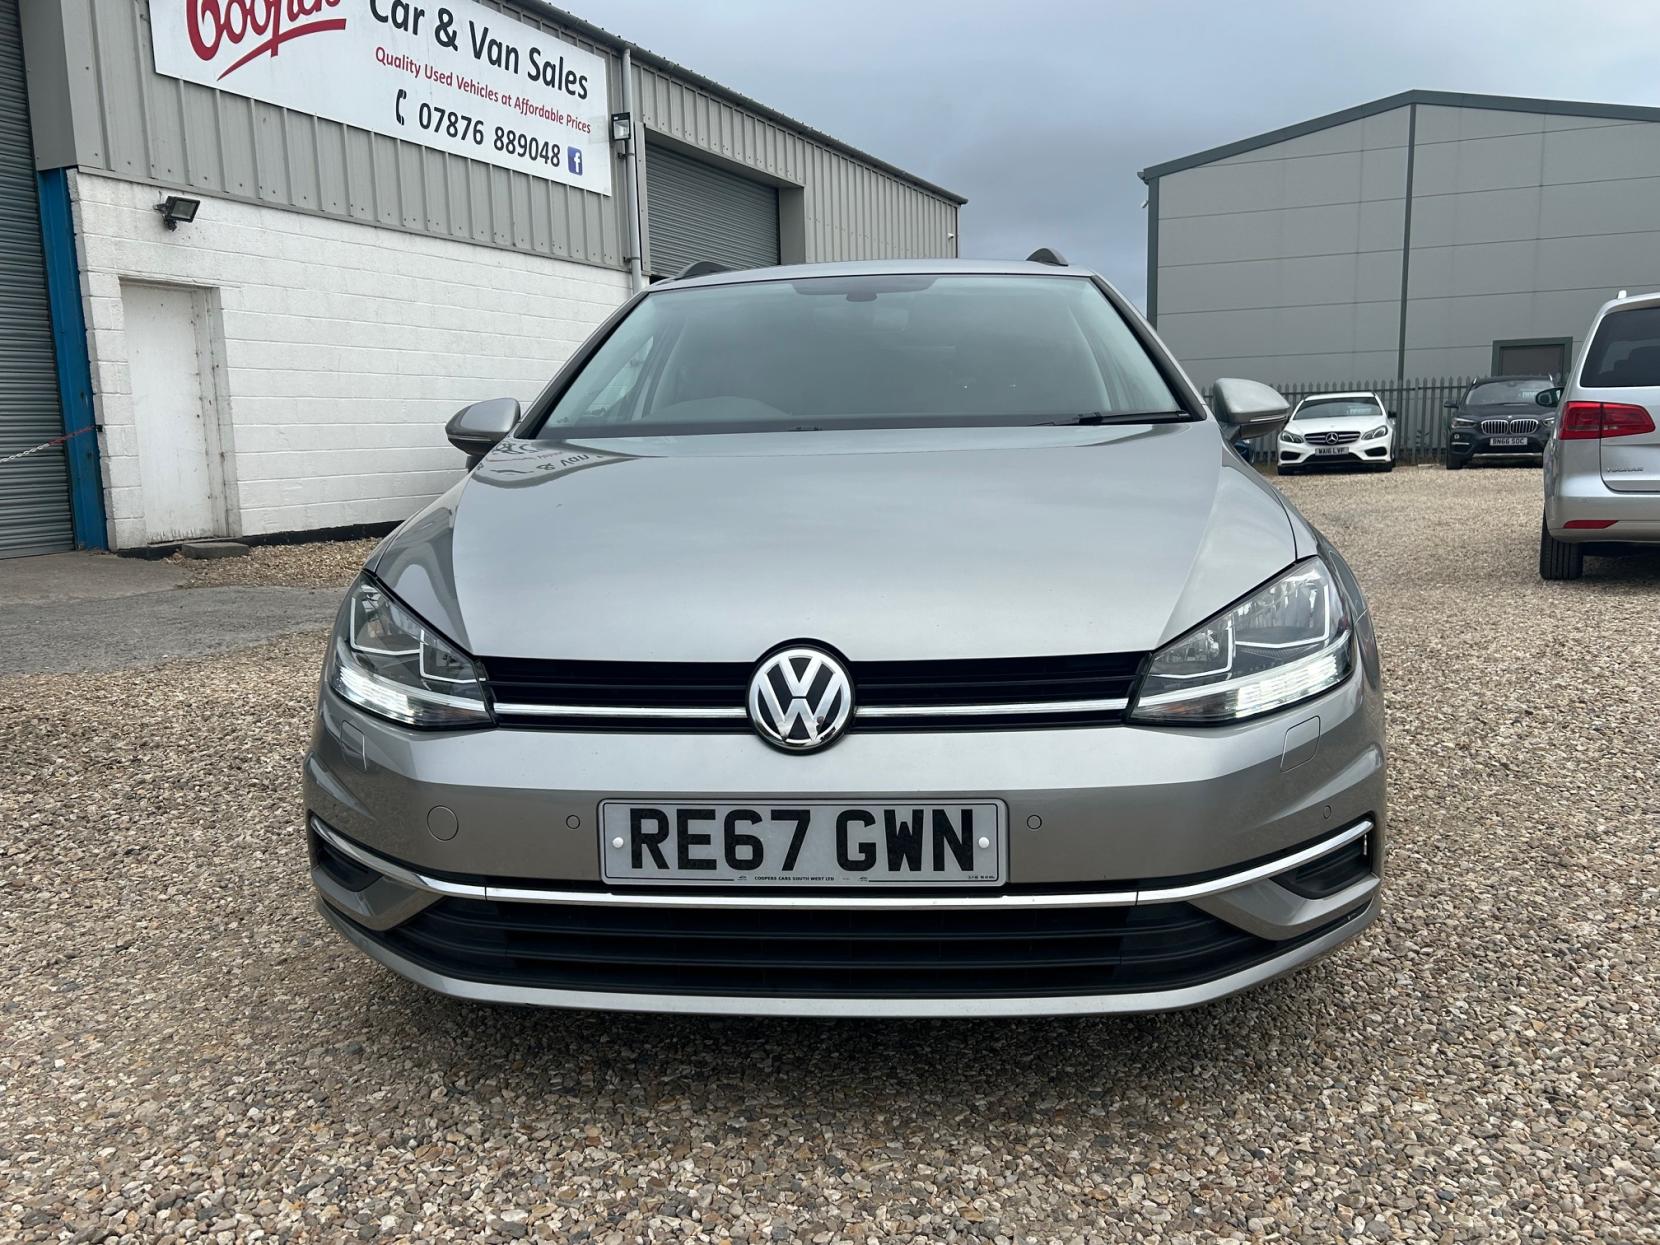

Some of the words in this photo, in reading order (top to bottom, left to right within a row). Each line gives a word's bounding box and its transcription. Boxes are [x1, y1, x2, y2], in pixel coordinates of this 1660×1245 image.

[369, 0, 426, 36] Car
[434, 7, 459, 52] &
[468, 20, 520, 75] Van
[527, 46, 588, 100] Sales
[375, 46, 421, 79] Quality
[424, 63, 453, 87] Used
[456, 74, 499, 103] Vehicles
[501, 94, 512, 108] at
[514, 96, 564, 126] Affordable
[566, 113, 592, 135] Prices
[418, 102, 485, 146] 07876
[493, 126, 561, 168] 889048
[629, 808, 811, 871] RE67
[835, 808, 974, 872] GWN
